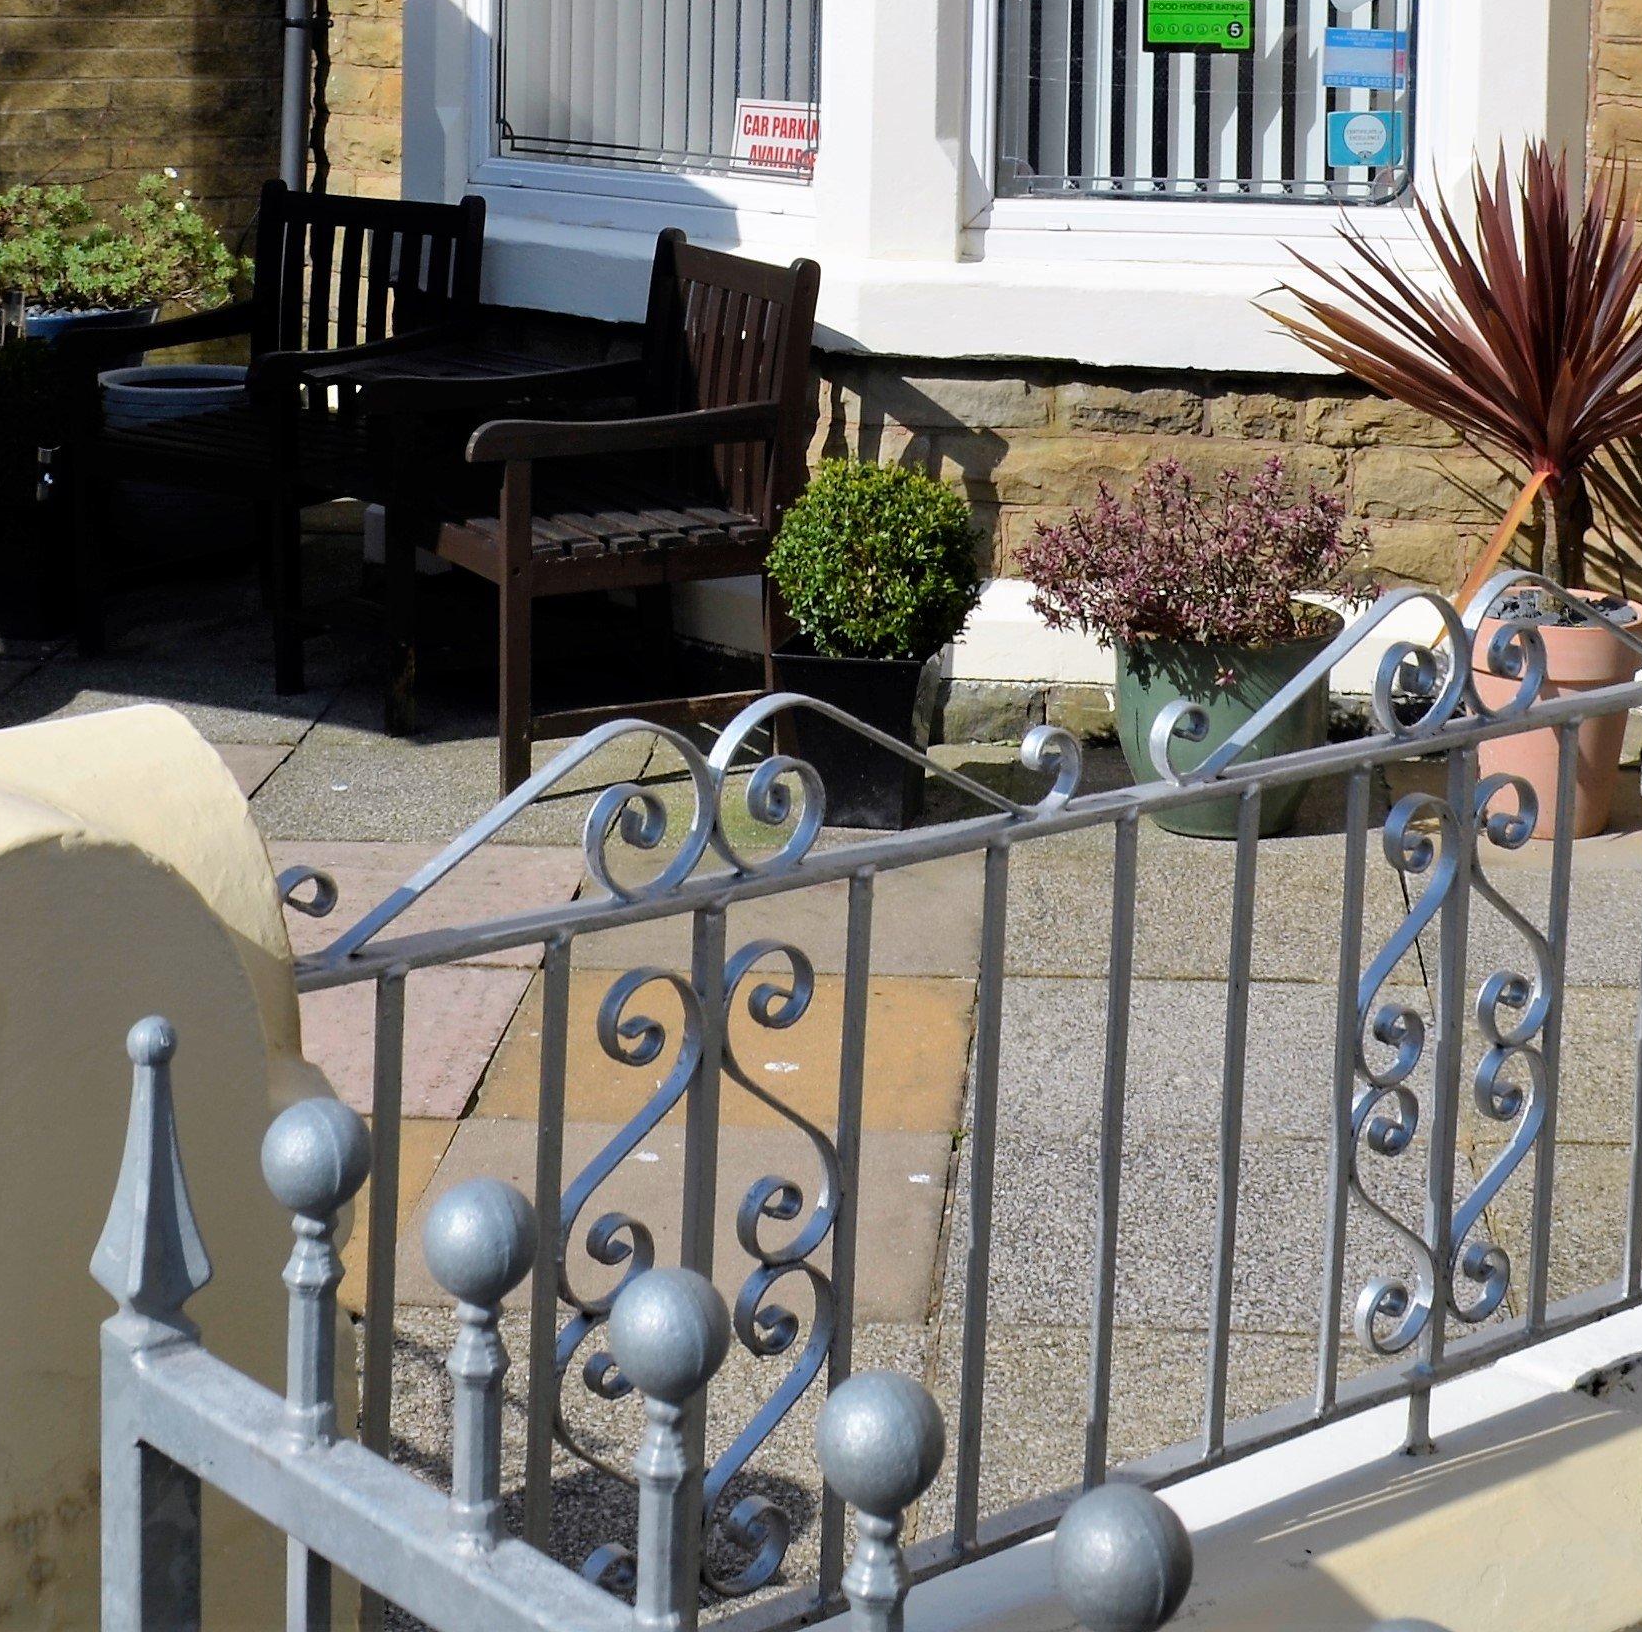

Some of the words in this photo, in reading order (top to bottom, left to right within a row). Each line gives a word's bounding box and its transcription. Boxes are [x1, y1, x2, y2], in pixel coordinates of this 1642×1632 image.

[1153, 2, 1178, 11] FOOD
[1179, 3, 1214, 11] HYGIENE
[1215, 3, 1245, 11] RATING
[1230, 24, 1240, 37] 5
[743, 114, 769, 137] CAR
